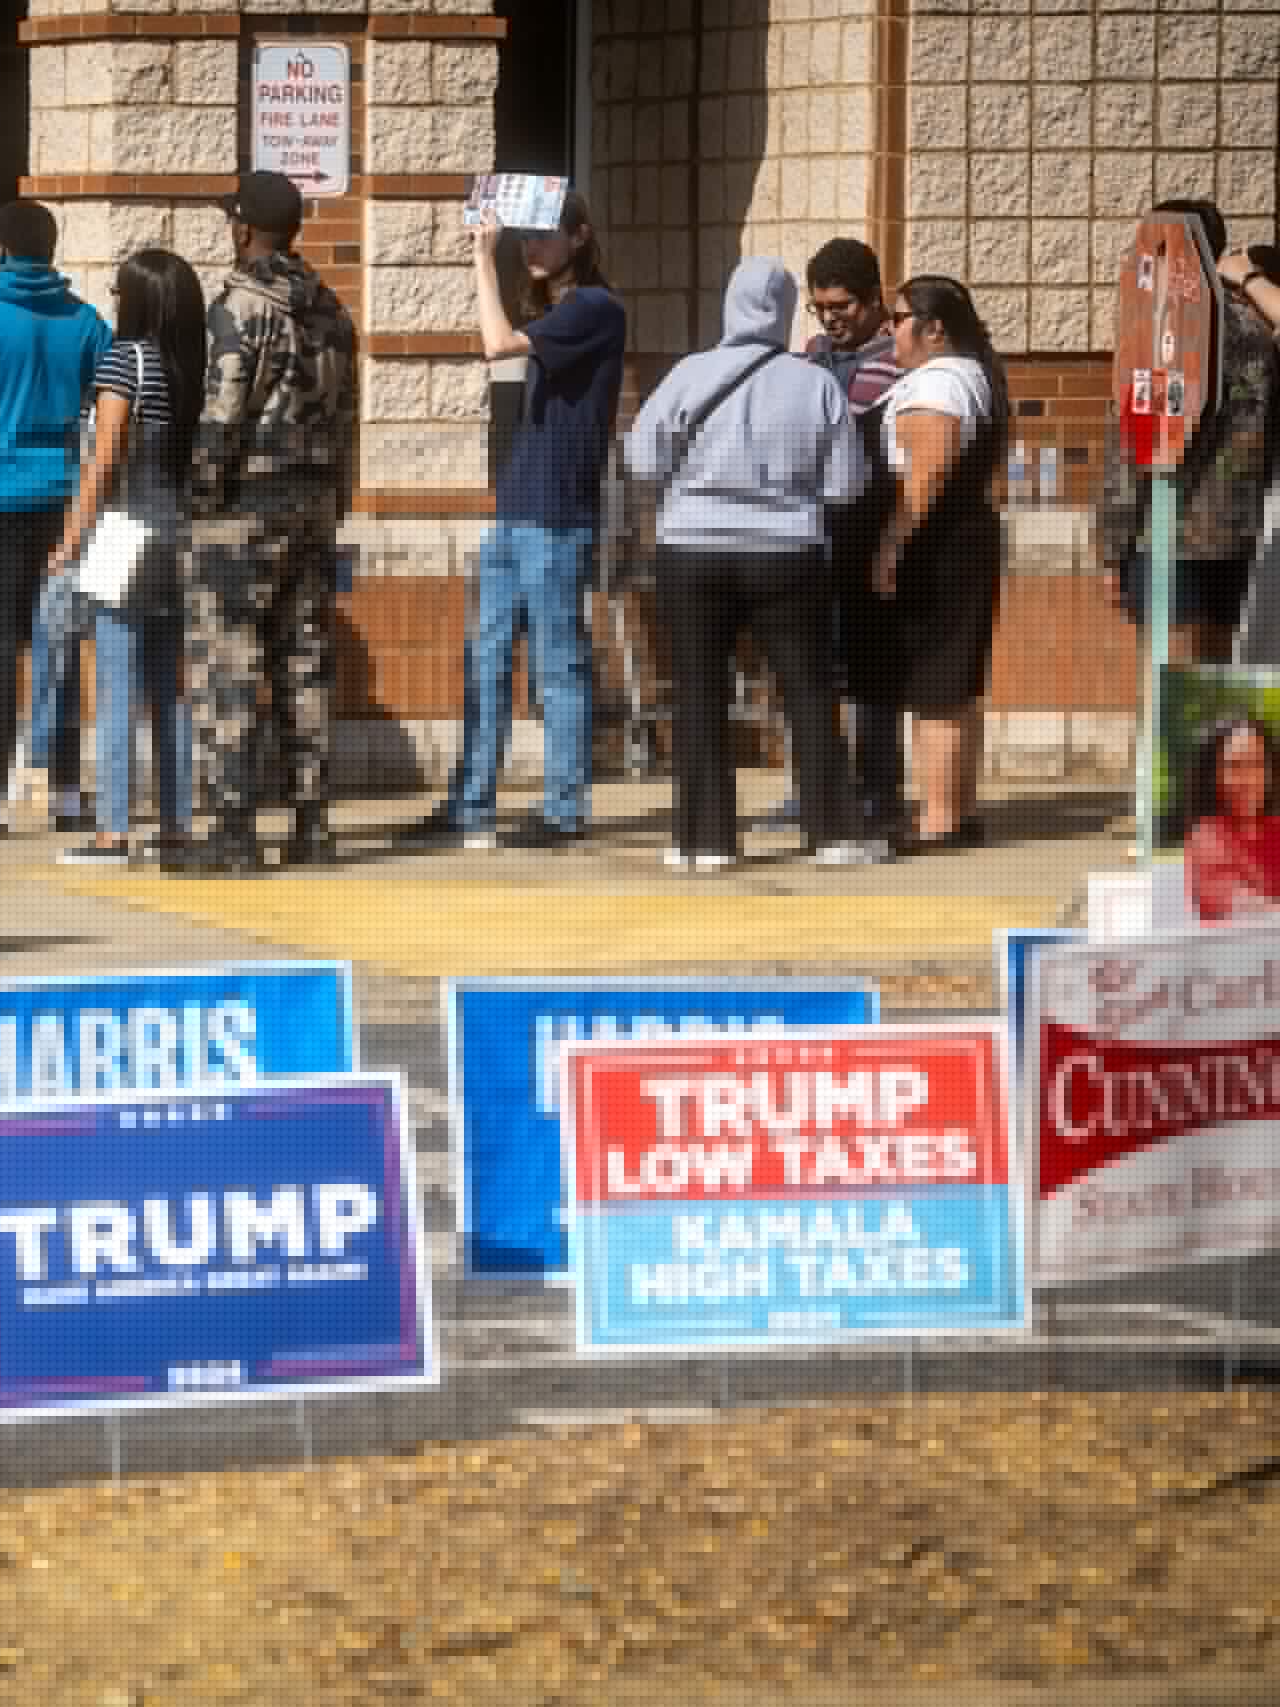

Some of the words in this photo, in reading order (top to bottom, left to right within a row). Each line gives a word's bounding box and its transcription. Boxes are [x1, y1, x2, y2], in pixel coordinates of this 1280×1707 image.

[258, 84, 344, 104] PARKING
[288, 57, 314, 79] NO
[261, 111, 293, 127] FIRE
[301, 111, 339, 127] LANE
[279, 151, 321, 167] ZONE
[639, 1069, 931, 1138] TRUMP
[1050, 1046, 1280, 1146] CUNNIN
[606, 1143, 755, 1194] LOW
[770, 1129, 978, 1186] TAXES
[674, 1202, 923, 1257] KAMALA
[631, 1257, 770, 1305] HIGH
[784, 1246, 969, 1297] TAXES
